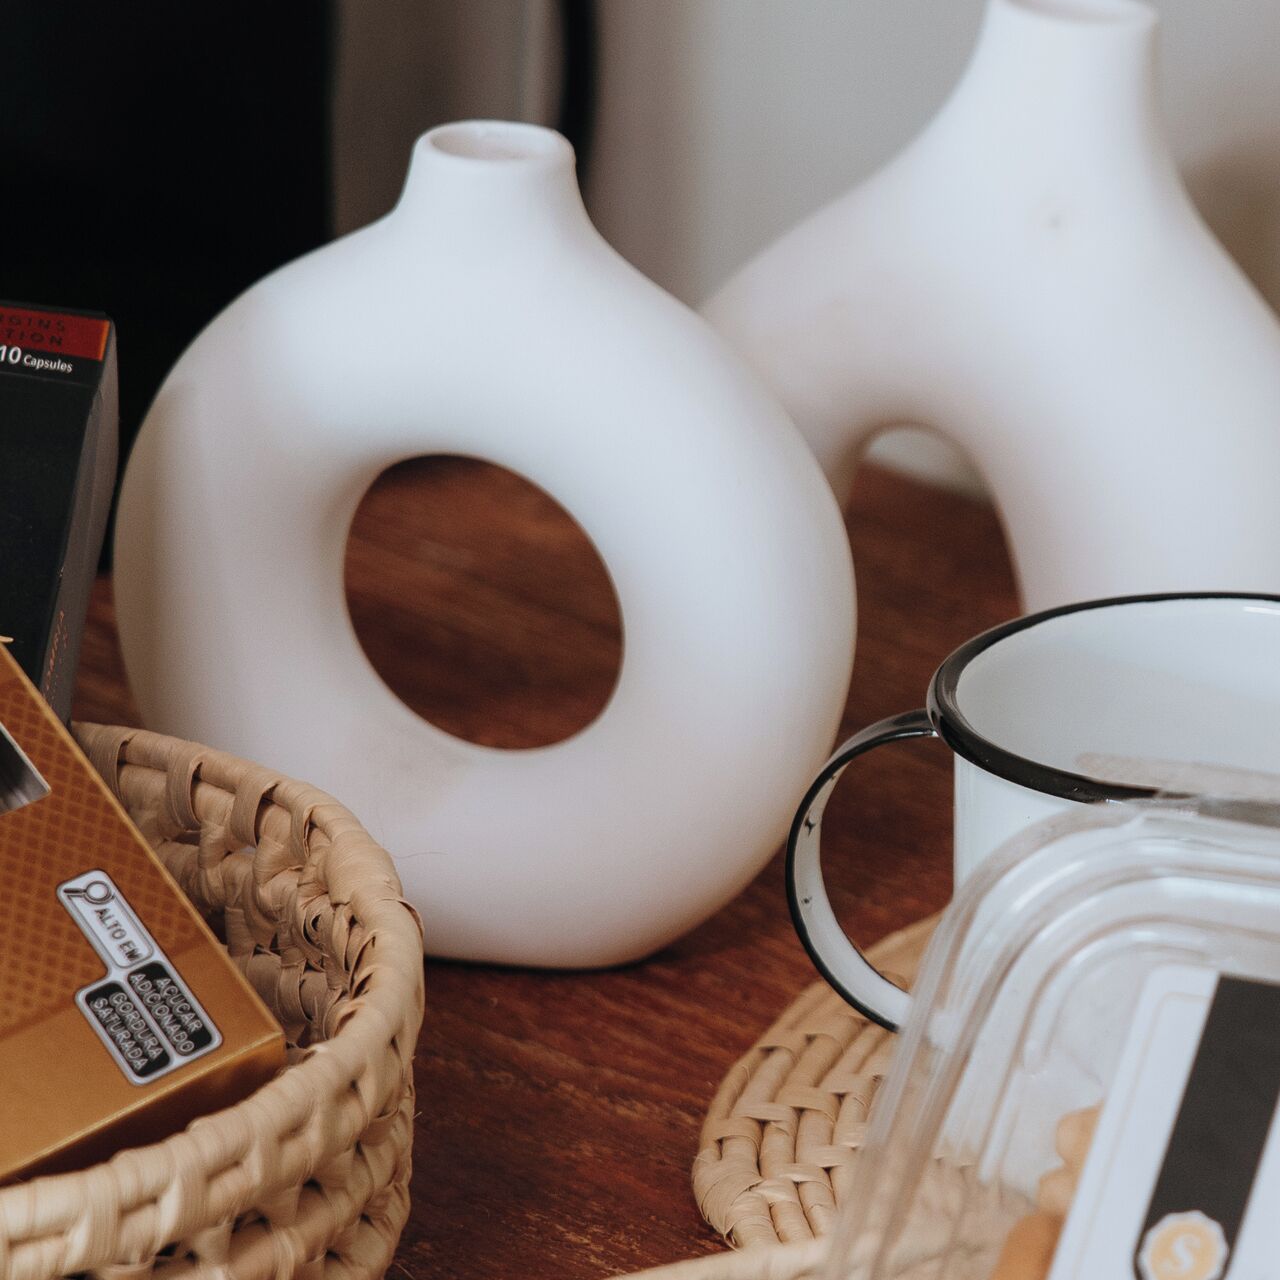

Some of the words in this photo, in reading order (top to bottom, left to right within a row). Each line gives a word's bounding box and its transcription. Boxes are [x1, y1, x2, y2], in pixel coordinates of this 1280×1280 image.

[0, 345, 22, 365] 10
[23, 353, 74, 374] Capsules
[94, 907, 128, 941] ALTO
[119, 940, 144, 963] EM
[90, 996, 149, 1071] SATURADA
[109, 991, 165, 1061] GORDURA
[130, 973, 196, 1055] ADICIONADO
